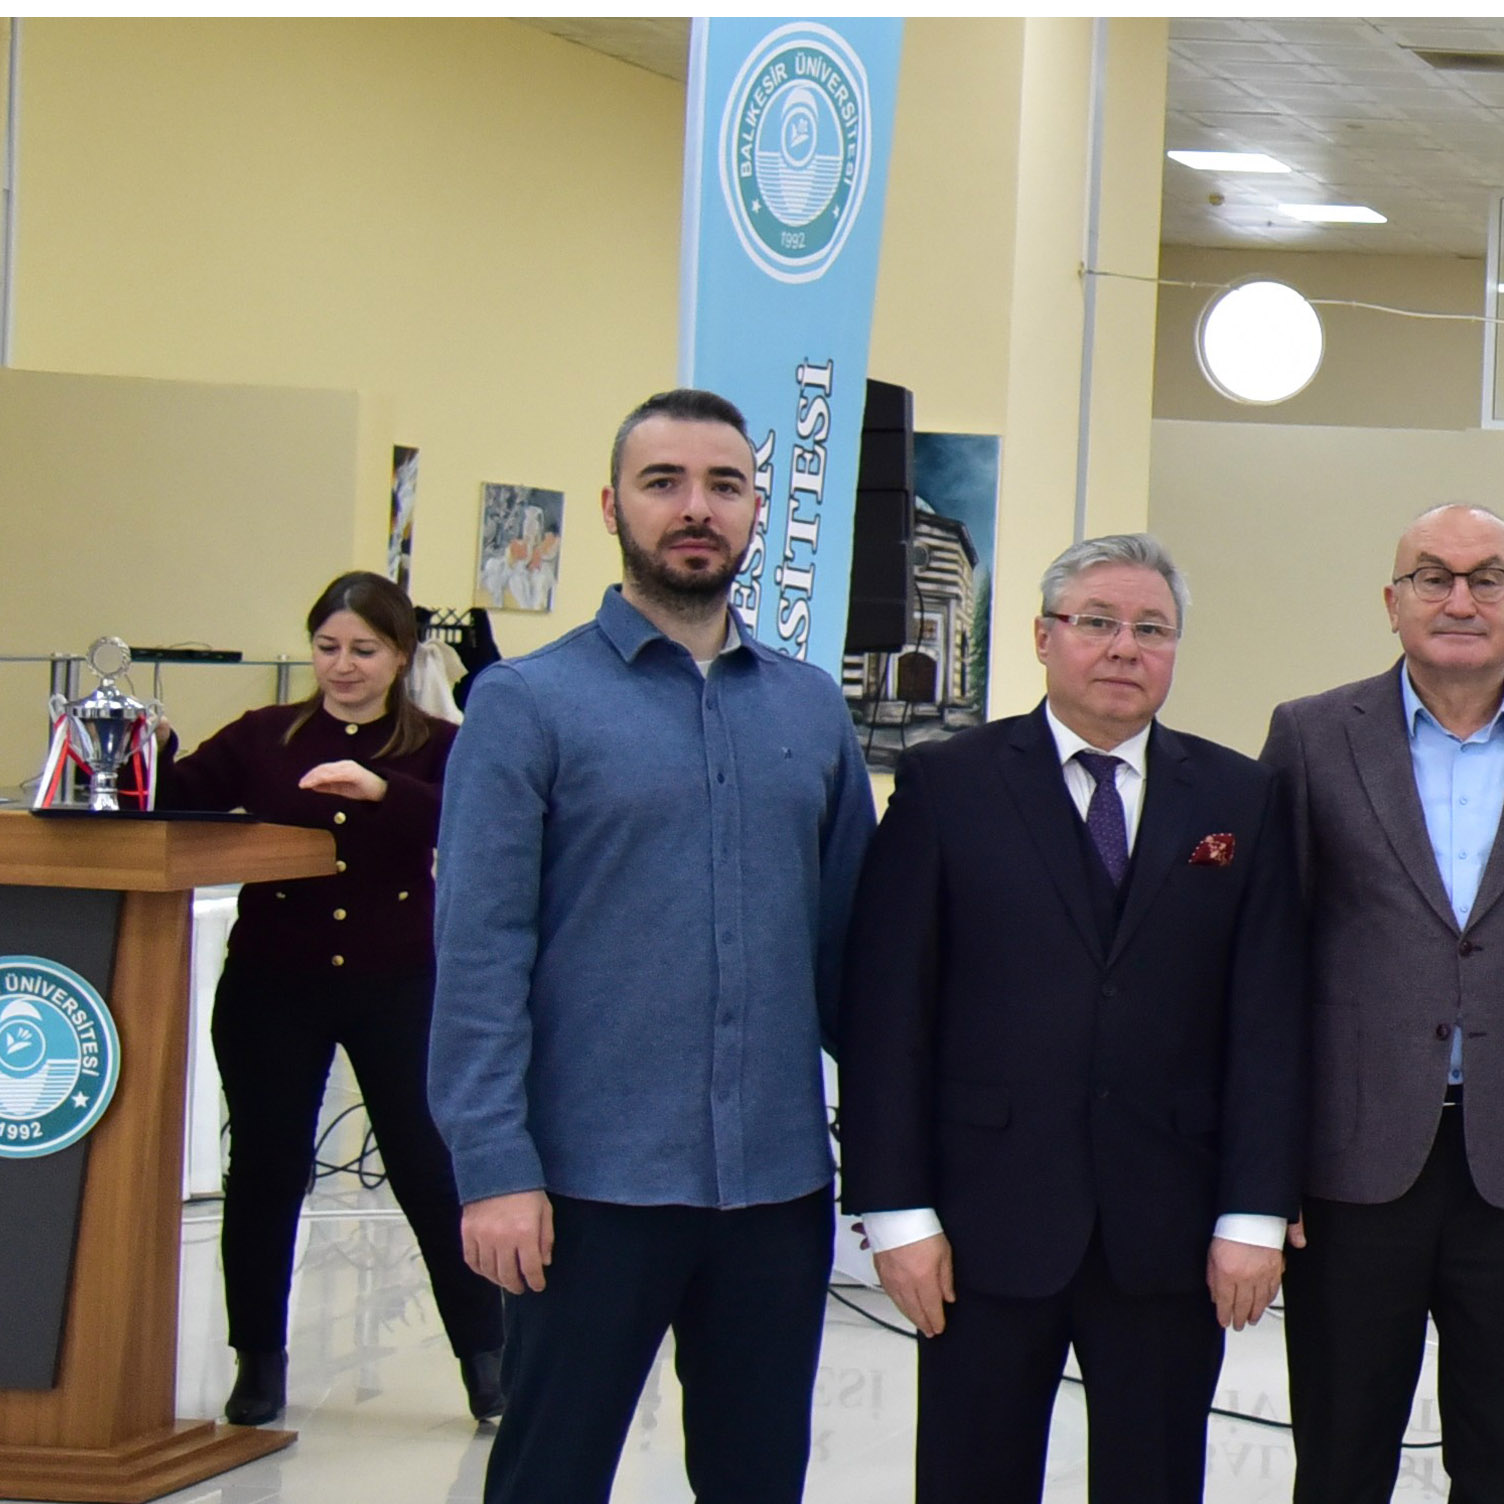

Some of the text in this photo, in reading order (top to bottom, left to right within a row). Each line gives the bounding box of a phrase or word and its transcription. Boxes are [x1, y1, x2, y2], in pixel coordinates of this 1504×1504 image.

[741, 53, 858, 185] BALIKESİR ÜNİVERSİTESİ
[781, 232, 805, 249] 1992
[774, 358, 833, 661] SİTESİ
[6, 973, 99, 1077] ÜNİVERSİTESİ
[0, 1122, 43, 1139] 1992
